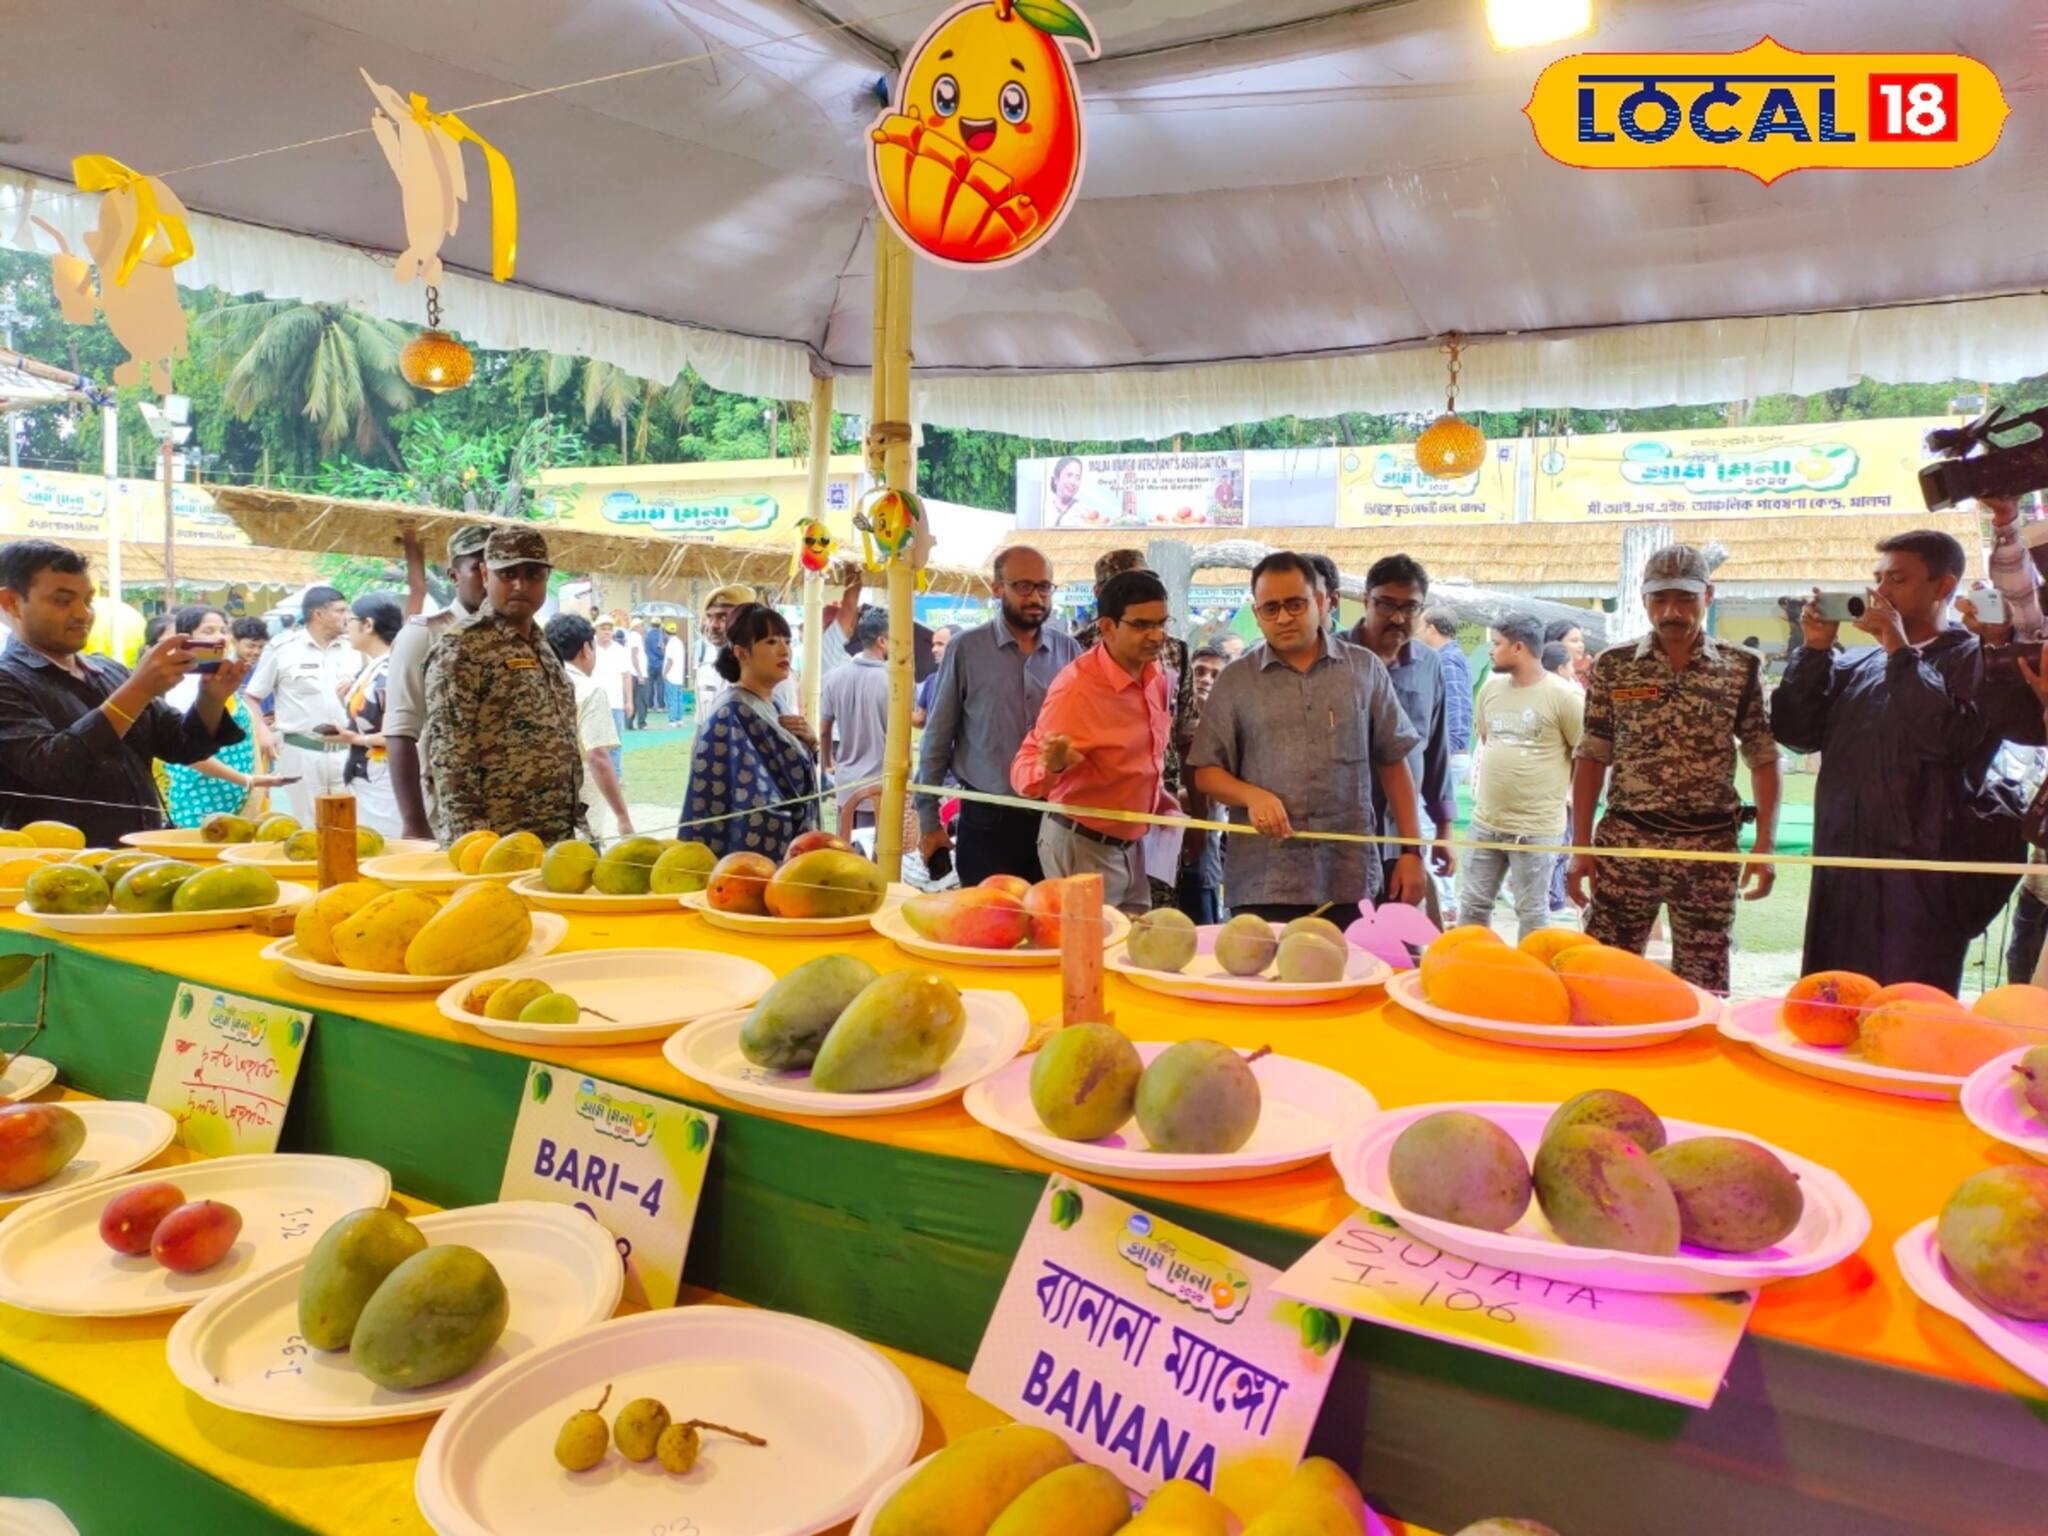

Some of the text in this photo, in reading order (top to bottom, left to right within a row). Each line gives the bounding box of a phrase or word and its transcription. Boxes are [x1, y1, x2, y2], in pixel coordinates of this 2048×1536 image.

[533, 1137, 665, 1218] BARI-4
[1125, 1241, 1166, 1270] আম
[1165, 1259, 1213, 1293] মেলা
[1335, 1228, 1605, 1310] SUJATA
[1035, 1258, 1290, 1437] ব্যানানা ম্যাঙ্গো
[1021, 1349, 1217, 1496] BANANA
